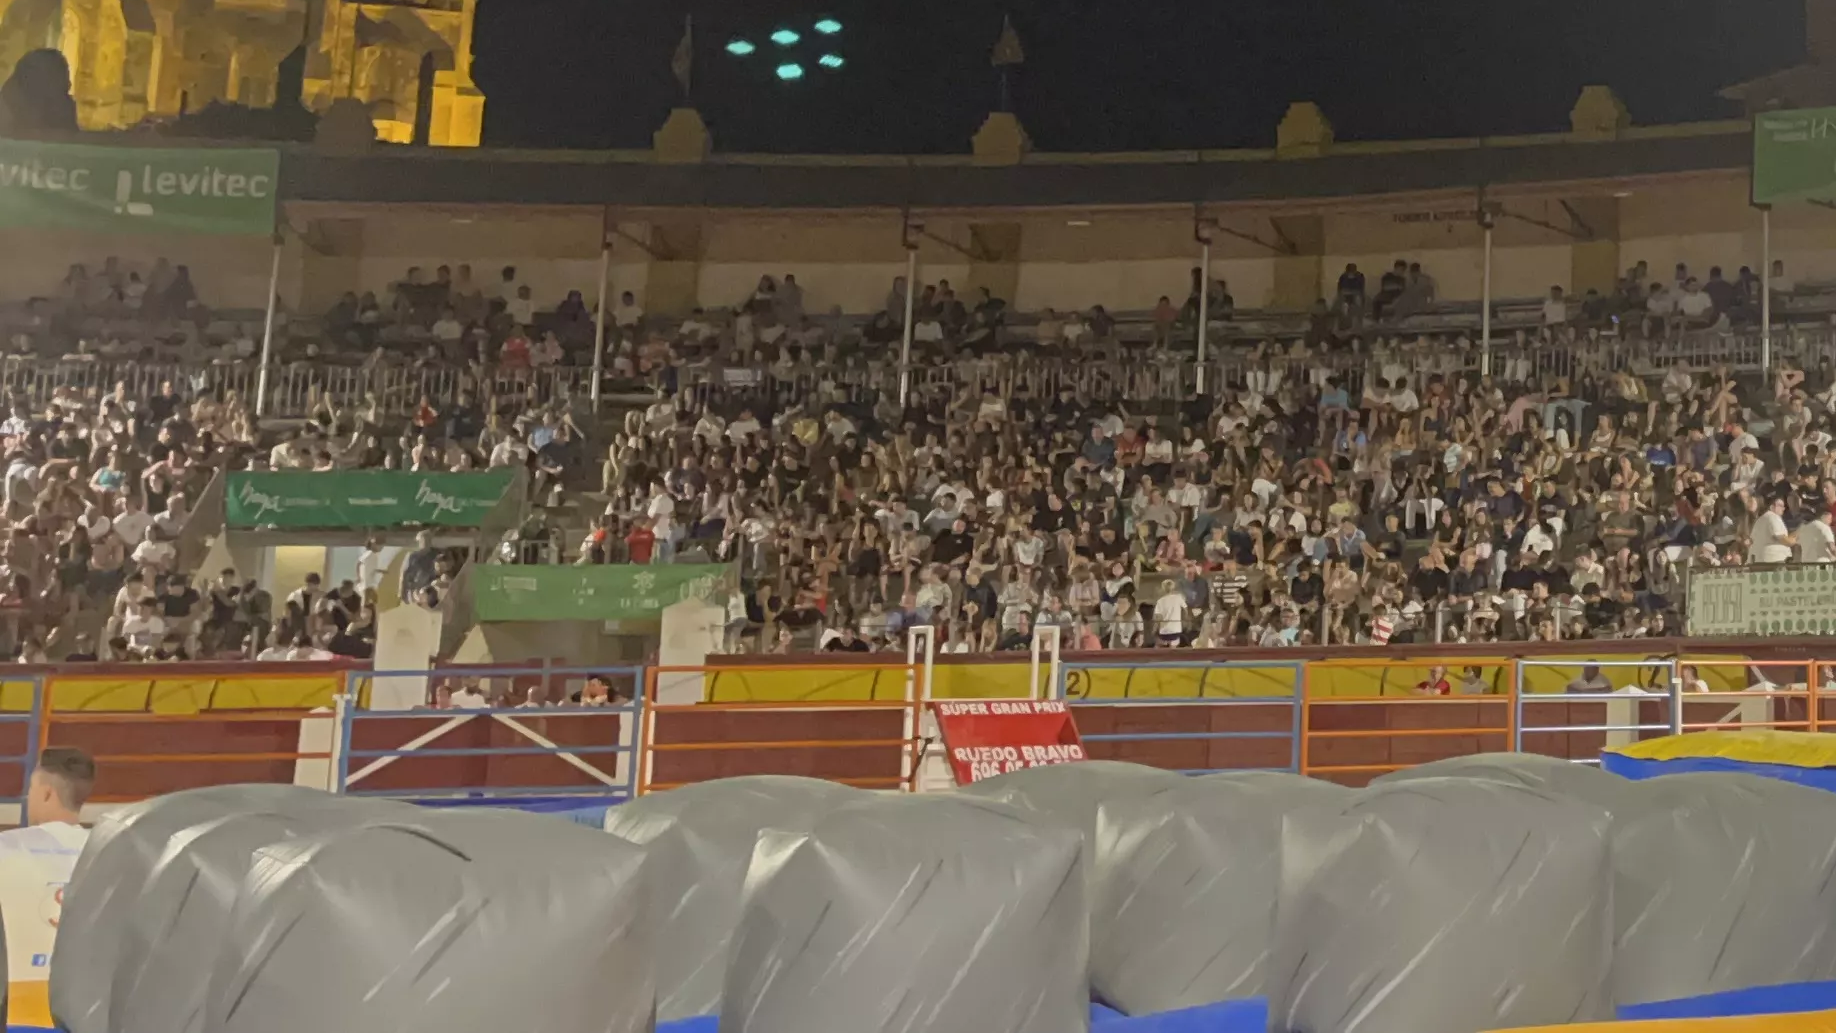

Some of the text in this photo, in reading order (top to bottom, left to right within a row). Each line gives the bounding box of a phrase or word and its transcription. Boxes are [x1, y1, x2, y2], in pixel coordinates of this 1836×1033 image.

[142, 164, 269, 198] levitec
[1066, 671, 1080, 695] 2
[940, 701, 1066, 715] SÚPER GRAN PRIX
[953, 744, 1083, 762] RUEDO BRAVO
